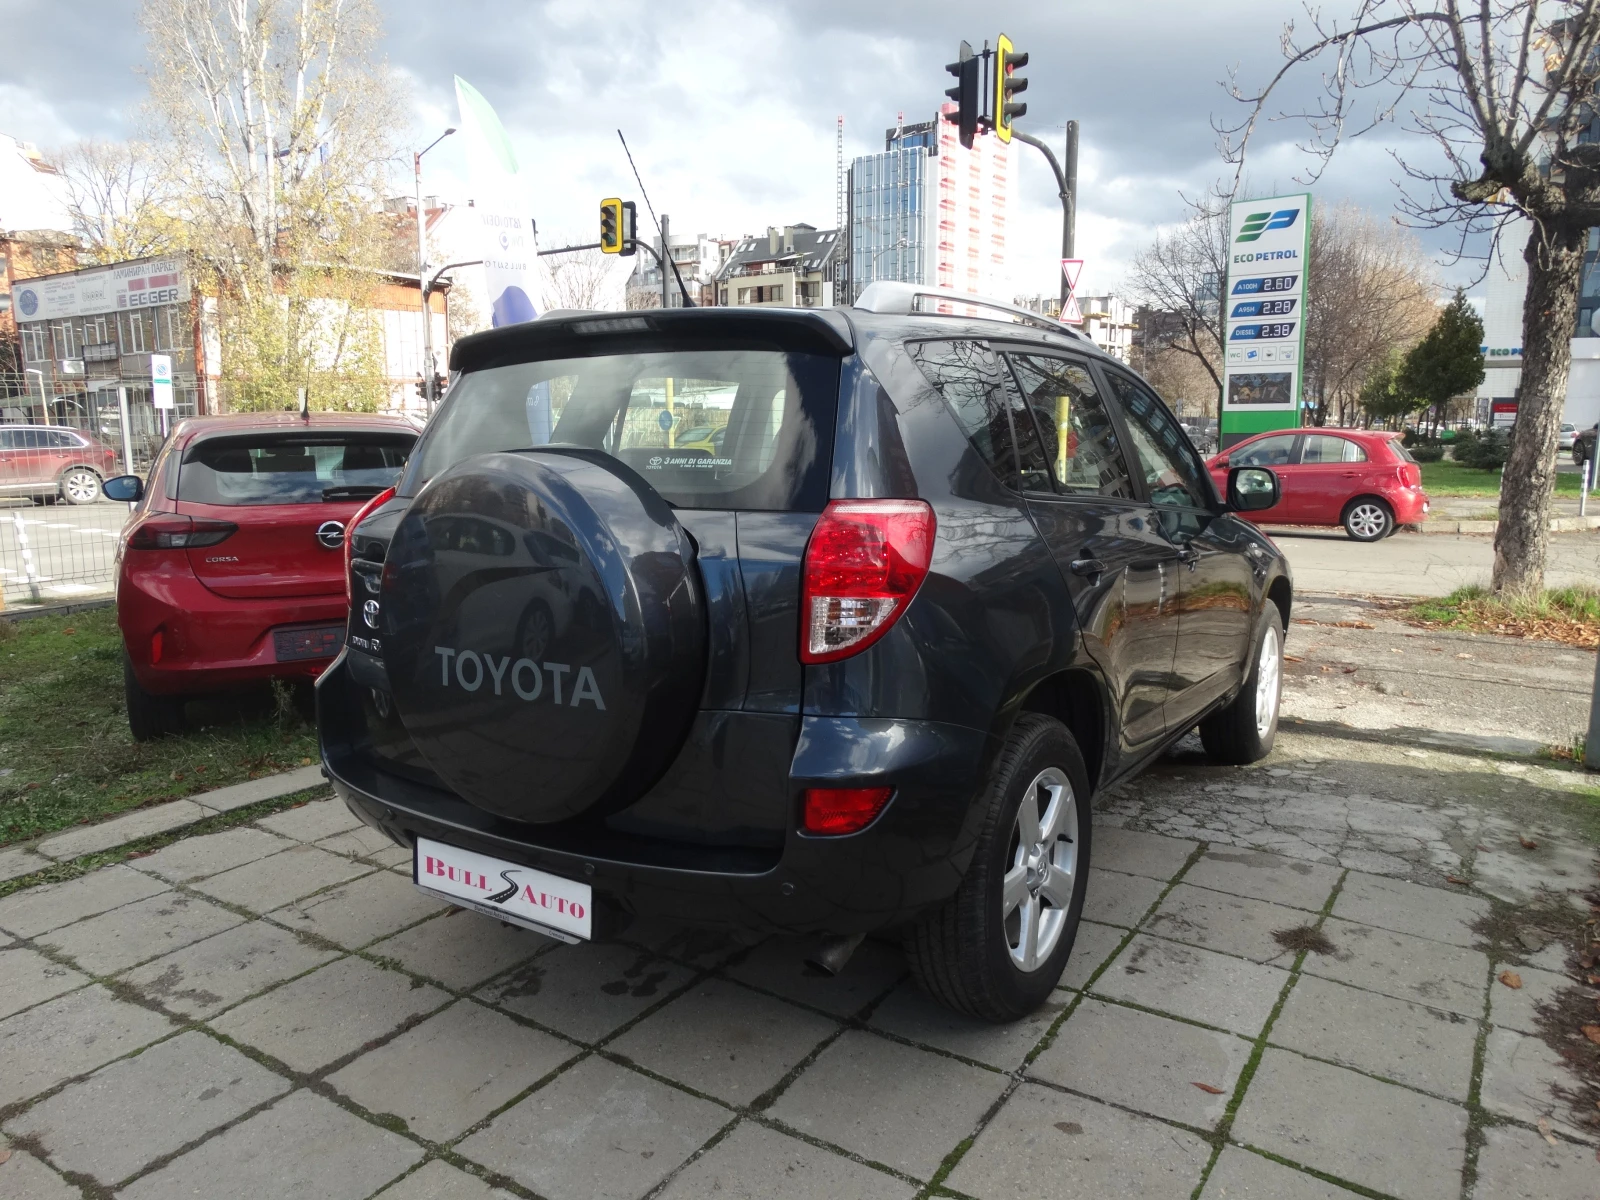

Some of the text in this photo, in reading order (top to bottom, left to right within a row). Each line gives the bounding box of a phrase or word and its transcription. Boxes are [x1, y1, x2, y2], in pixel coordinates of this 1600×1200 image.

[1263, 277, 1292, 291] 2.60
[128, 288, 179, 307] EGGER
[1262, 301, 1291, 314] 2.28
[1261, 324, 1290, 337] 2.38
[663, 457, 671, 465] 3
[434, 645, 607, 711] TOYOTA
[424, 855, 493, 892] BULL
[520, 884, 585, 919] AUTO
